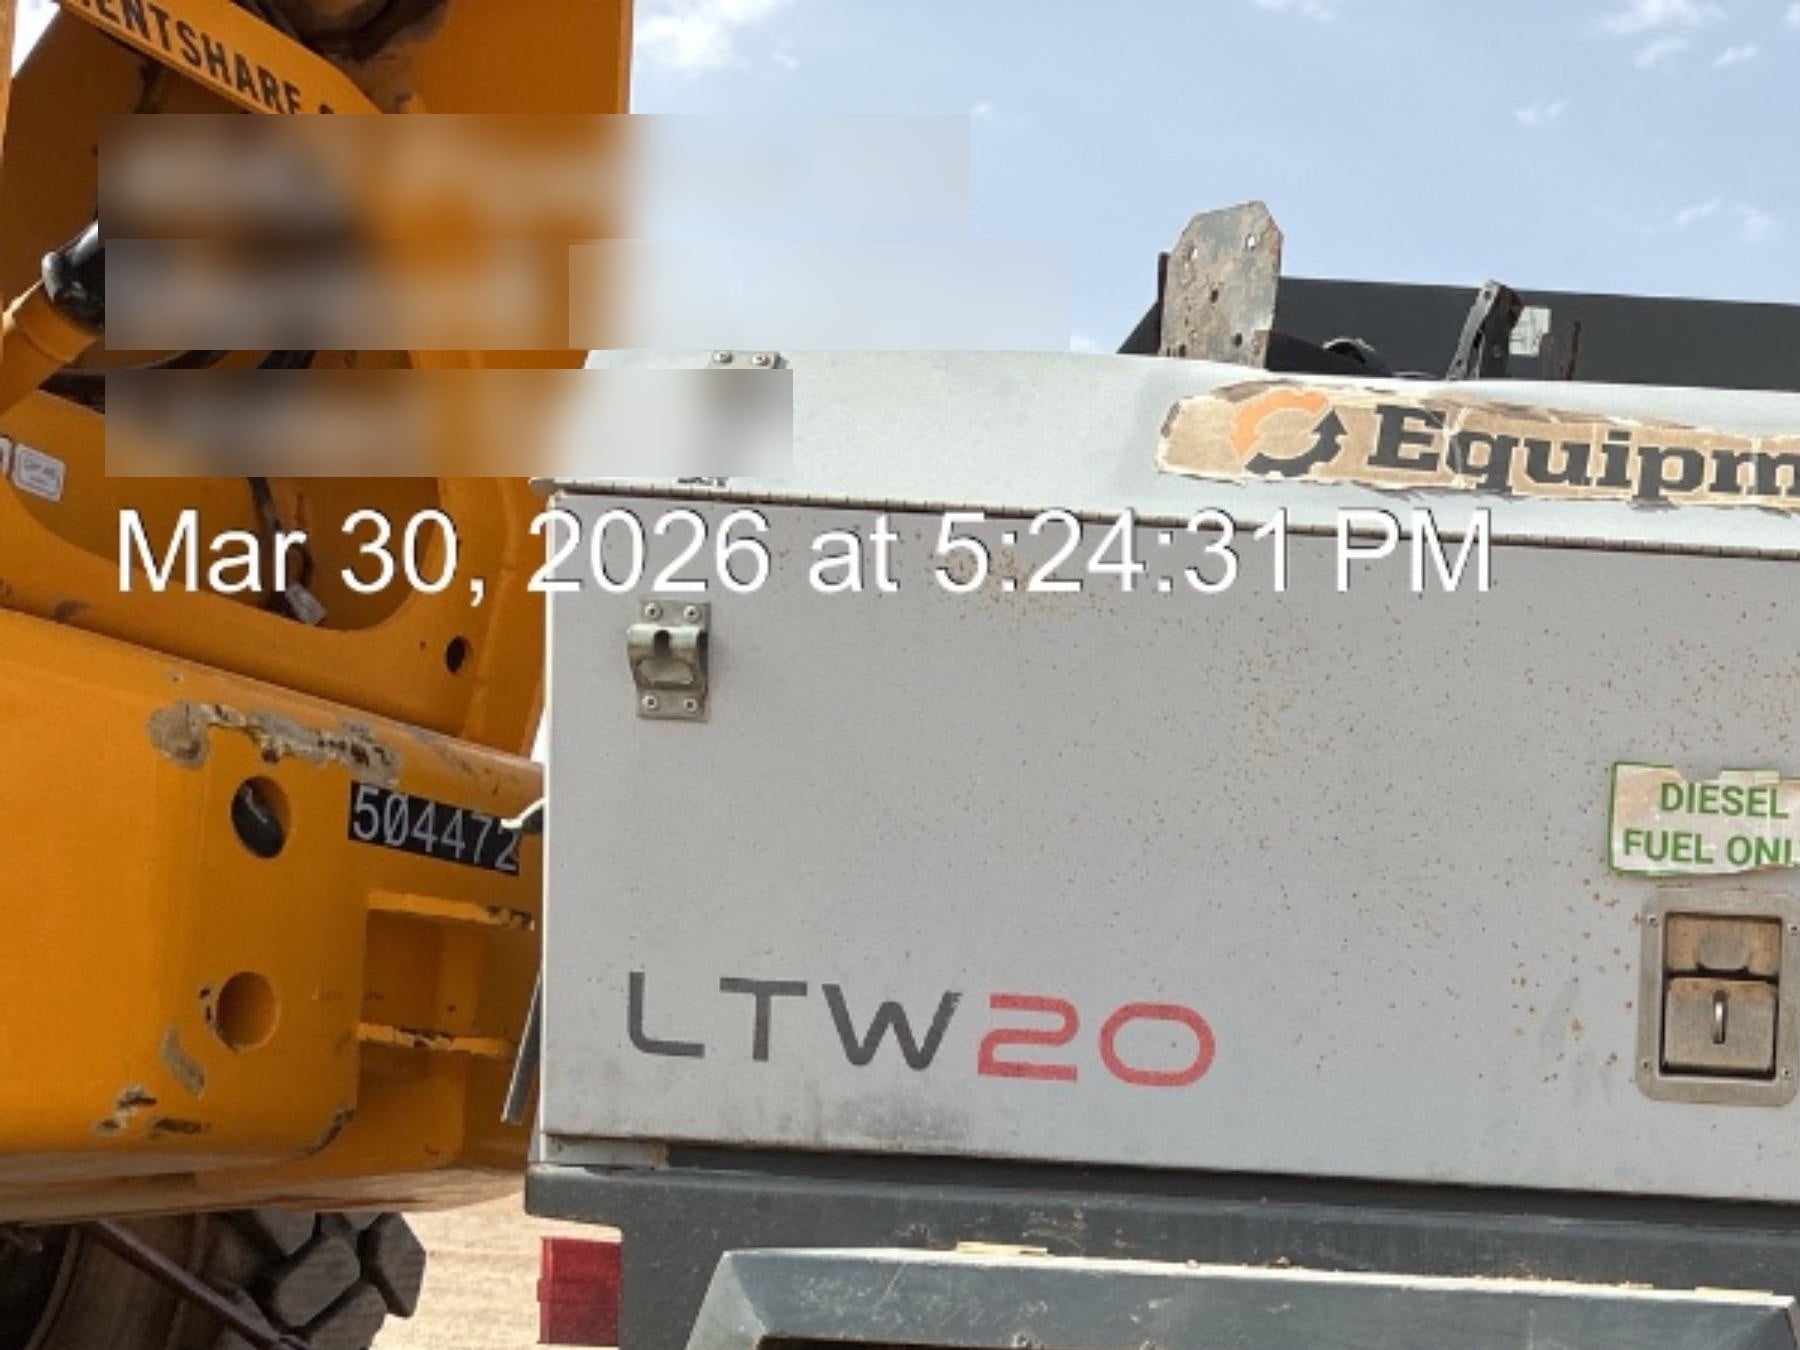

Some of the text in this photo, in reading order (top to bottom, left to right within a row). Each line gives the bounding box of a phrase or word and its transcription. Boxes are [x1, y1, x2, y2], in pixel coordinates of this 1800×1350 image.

[353, 784, 520, 871] 504472
[1660, 782, 1789, 819] DIESEL
[1622, 828, 1714, 864] FUEL
[627, 971, 1215, 1087] LTW20
